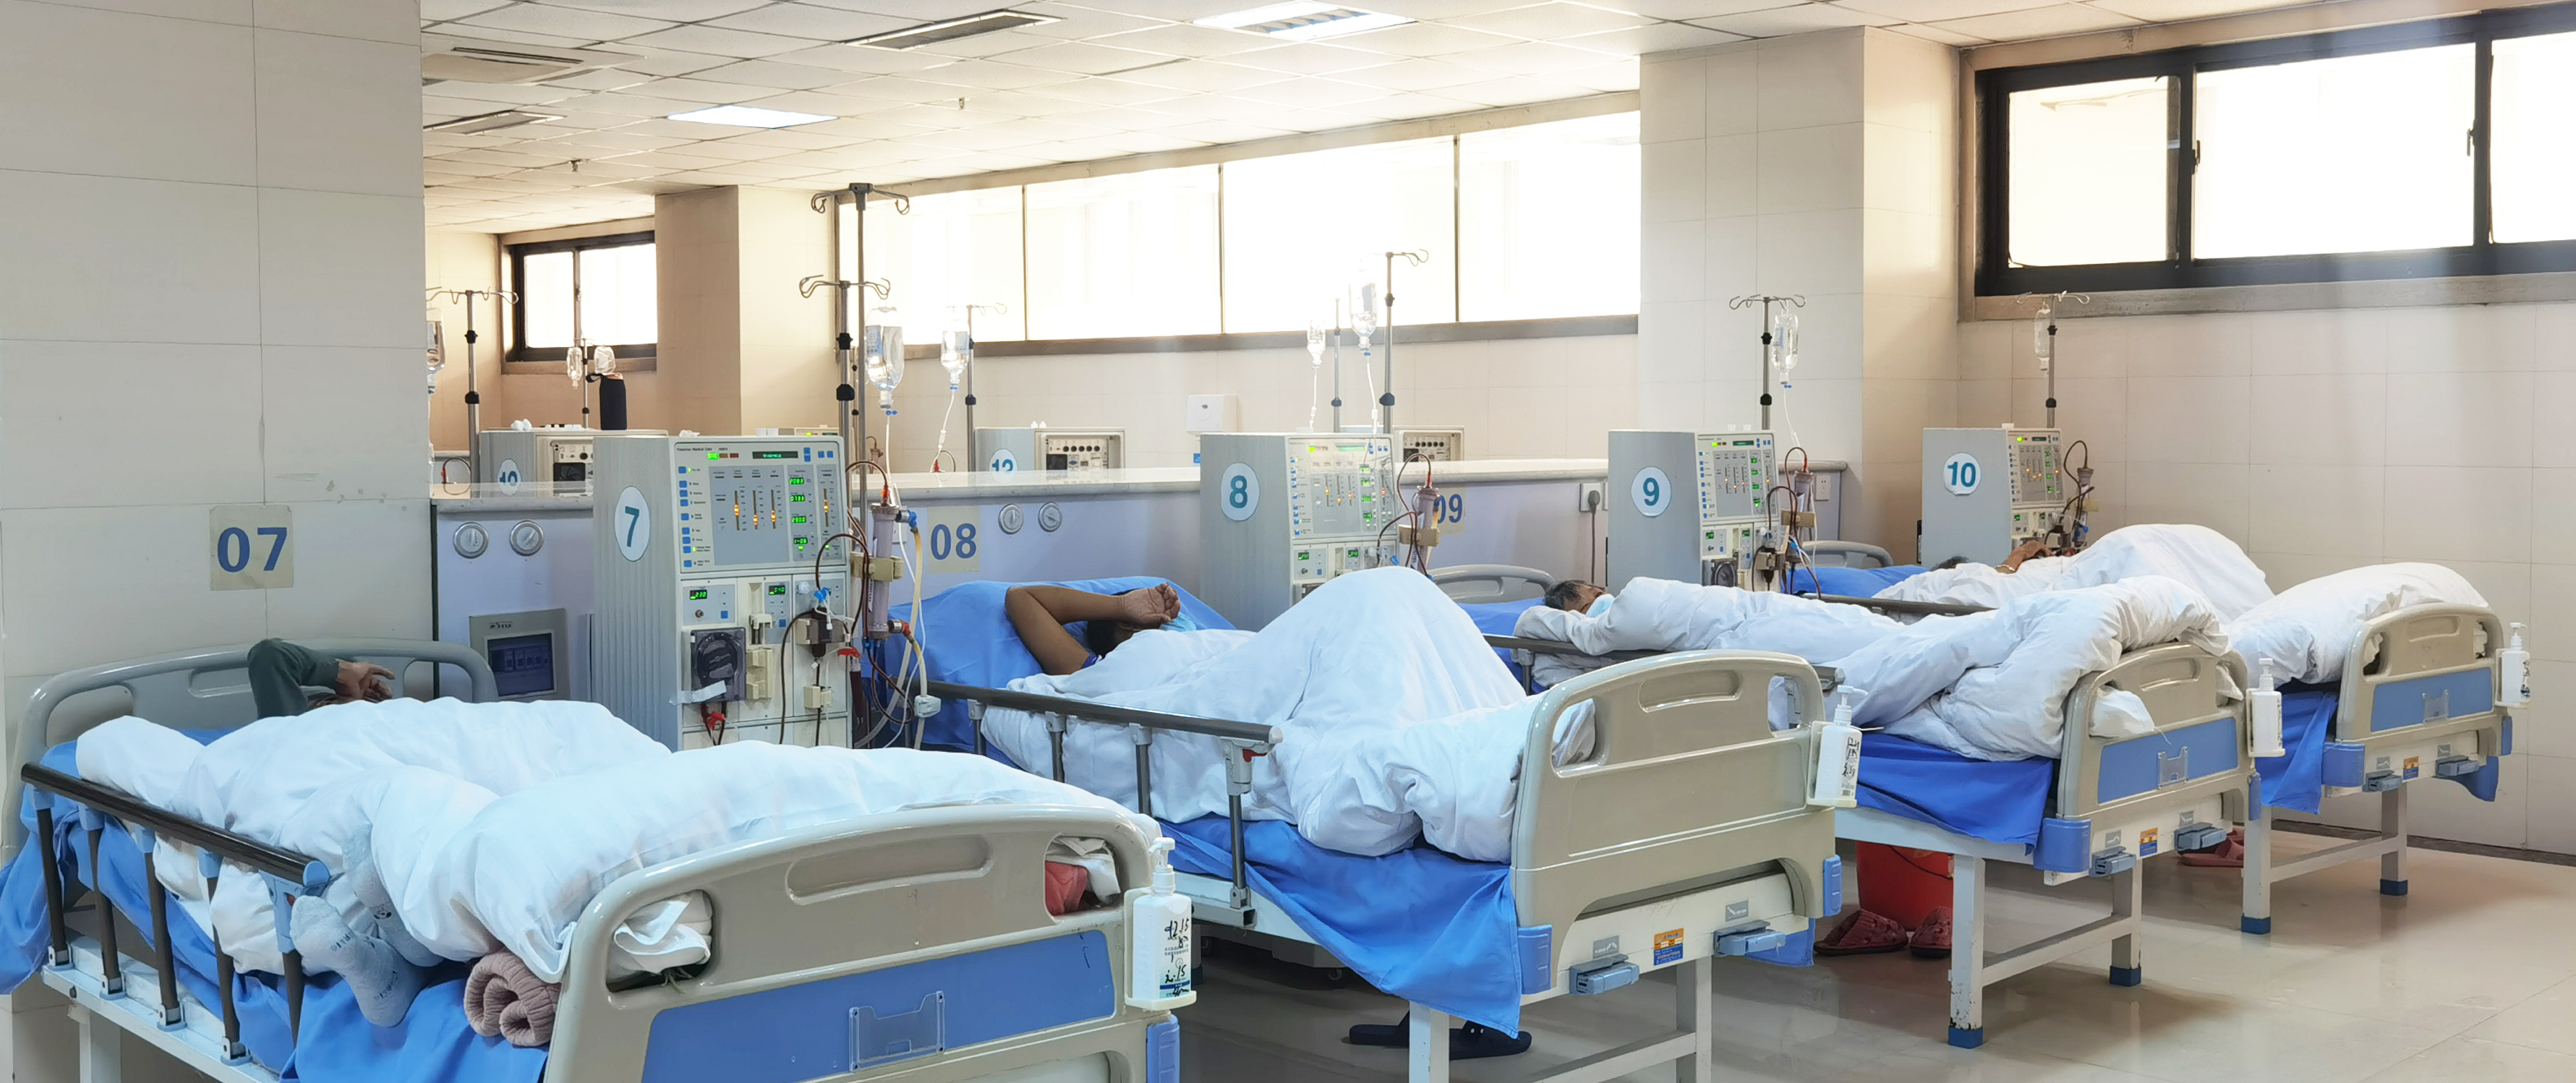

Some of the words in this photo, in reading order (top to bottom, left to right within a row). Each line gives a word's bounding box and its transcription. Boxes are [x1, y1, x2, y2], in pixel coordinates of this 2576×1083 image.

[1643, 477, 1659, 506] 9
[1948, 461, 1976, 487] 10
[1229, 475, 1248, 509] 8
[625, 506, 639, 547] 7
[931, 523, 976, 560] 08
[217, 527, 287, 573] 07
